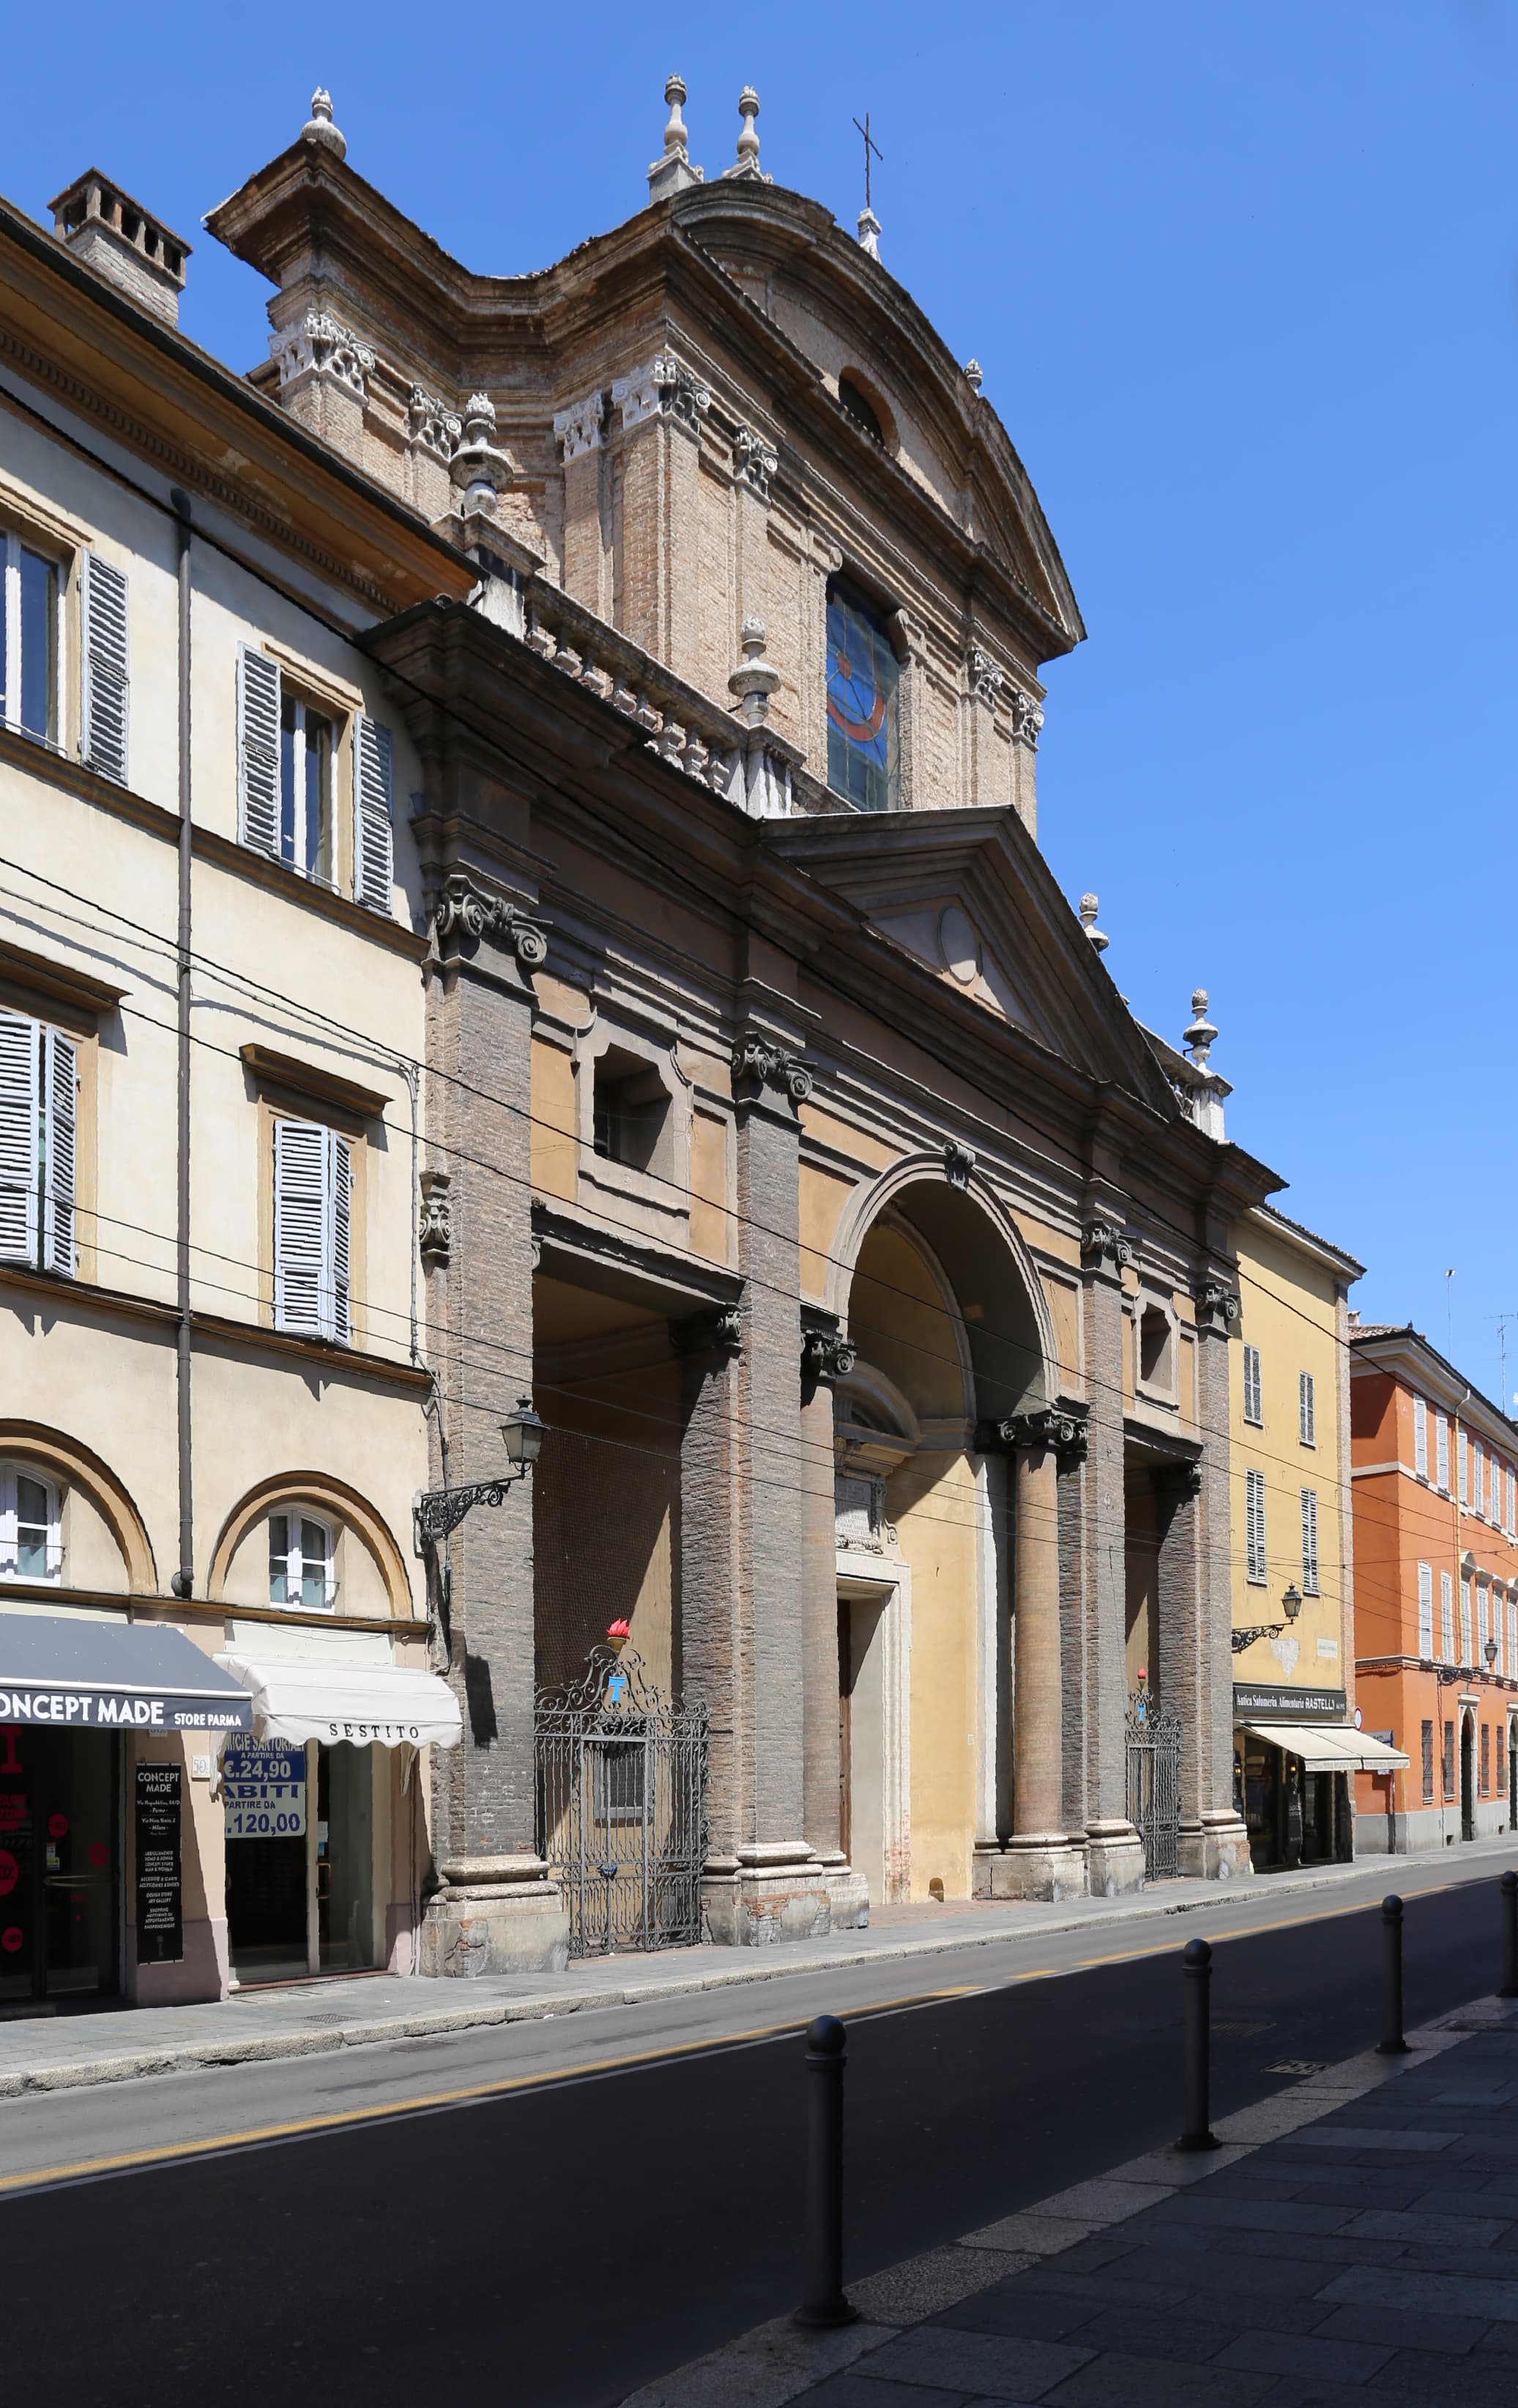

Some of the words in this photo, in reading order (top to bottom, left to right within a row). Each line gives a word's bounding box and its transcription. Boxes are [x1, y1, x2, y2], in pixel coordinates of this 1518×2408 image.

[1306, 1698, 1335, 1710] RASTELLI
[97, 1698, 164, 1725] MADE
[174, 1712, 206, 1726] STORE
[207, 1714, 242, 1727] PARMA
[330, 1723, 419, 1739] SESTITO
[138, 1772, 179, 1782] CONCEPT
[224, 1760, 291, 1782] €.24,90
[146, 1784, 171, 1792] MADE
[225, 1801, 261, 1809] PARTIRE
[264, 1801, 275, 1809] DA
[225, 1813, 300, 1835] .120,00
